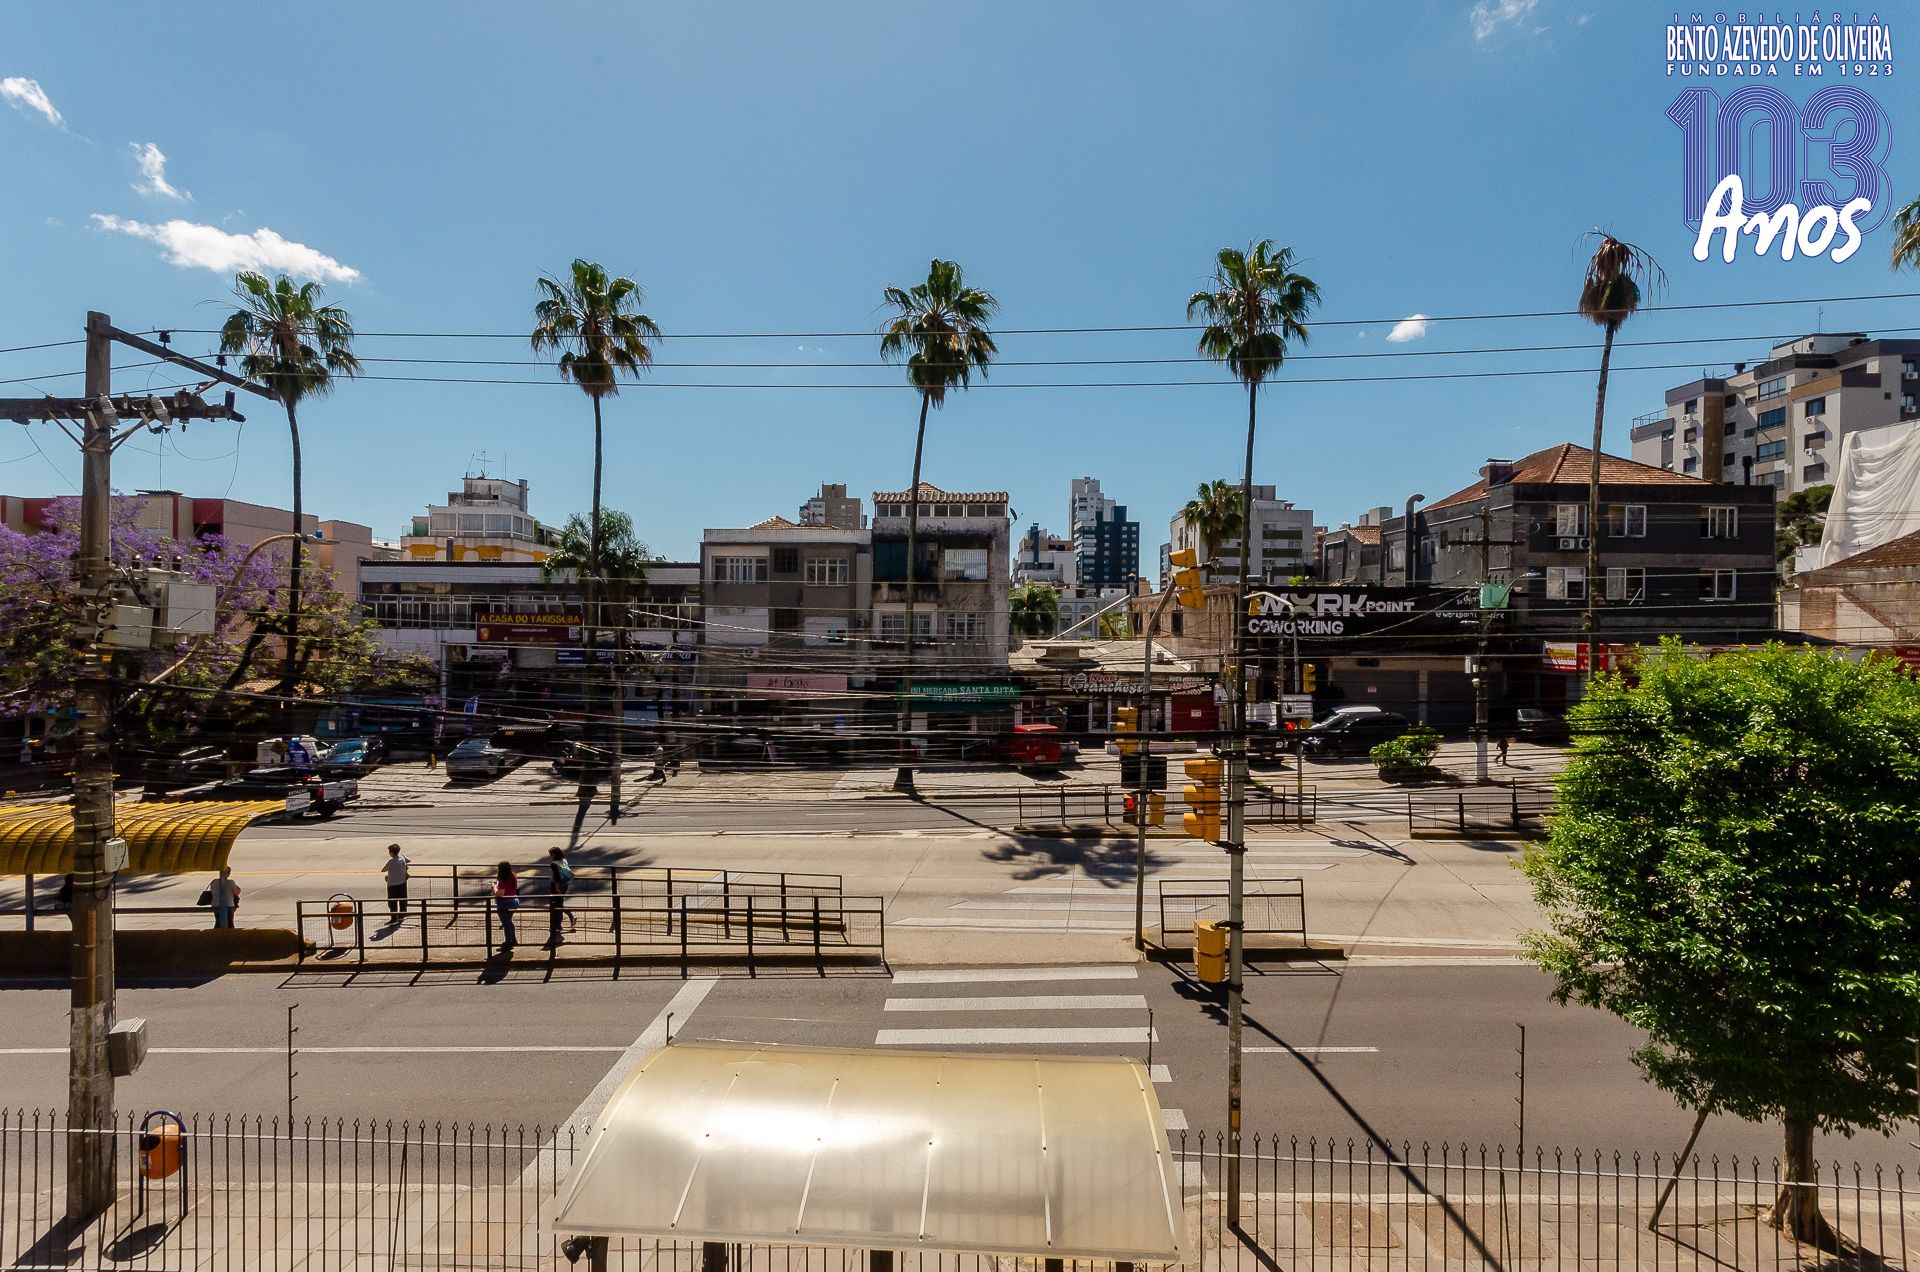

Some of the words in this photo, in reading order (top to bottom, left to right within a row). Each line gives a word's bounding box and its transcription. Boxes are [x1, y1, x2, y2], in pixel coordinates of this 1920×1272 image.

[480, 615, 486, 623] A
[489, 615, 512, 623] CASA
[515, 615, 528, 623] DO
[1248, 619, 1344, 635] COWORKING
[923, 687, 958, 695] MERCADO
[960, 686, 990, 694] SANTA
